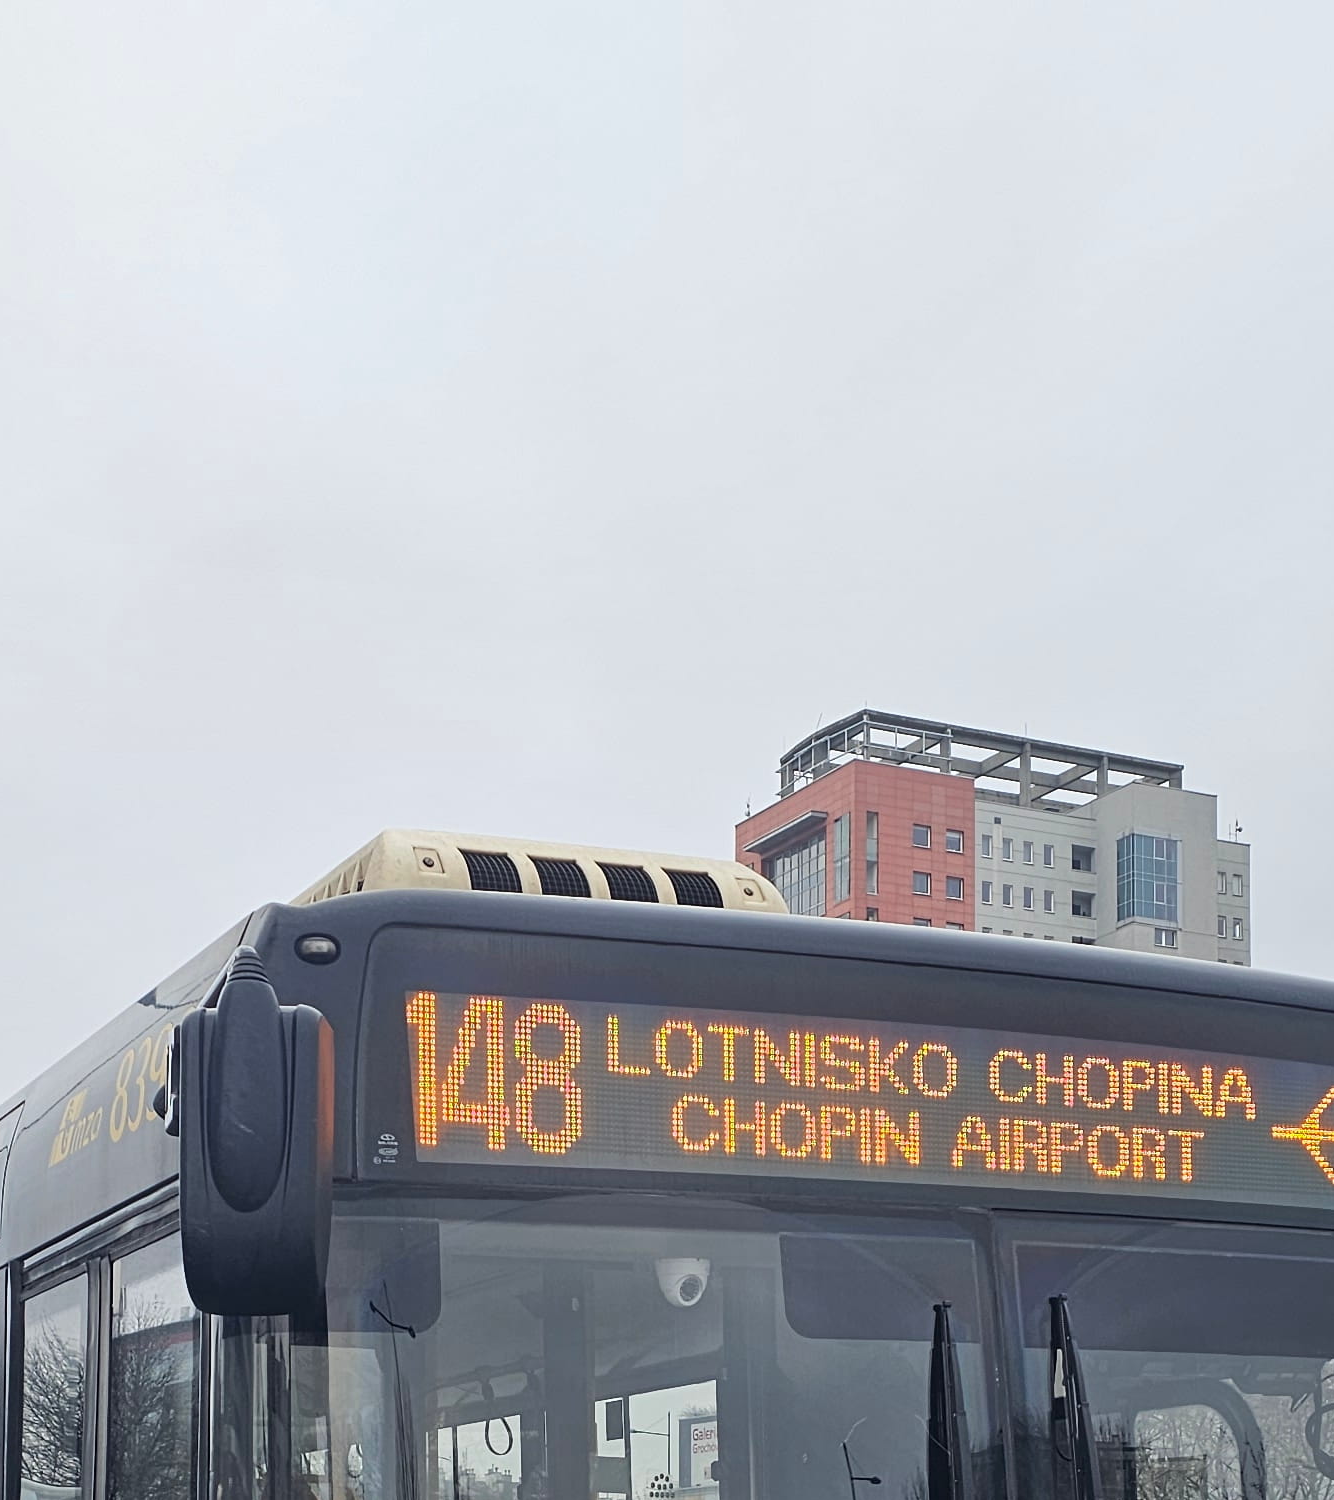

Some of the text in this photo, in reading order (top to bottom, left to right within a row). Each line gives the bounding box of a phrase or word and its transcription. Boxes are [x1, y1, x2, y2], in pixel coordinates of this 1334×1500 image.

[109, 1022, 174, 1143] 839
[405, 990, 583, 1154] 148
[606, 1012, 1257, 1120] LOTNISKO CHOPINA
[671, 1092, 1205, 1183] CHOPIN AIRPORT
